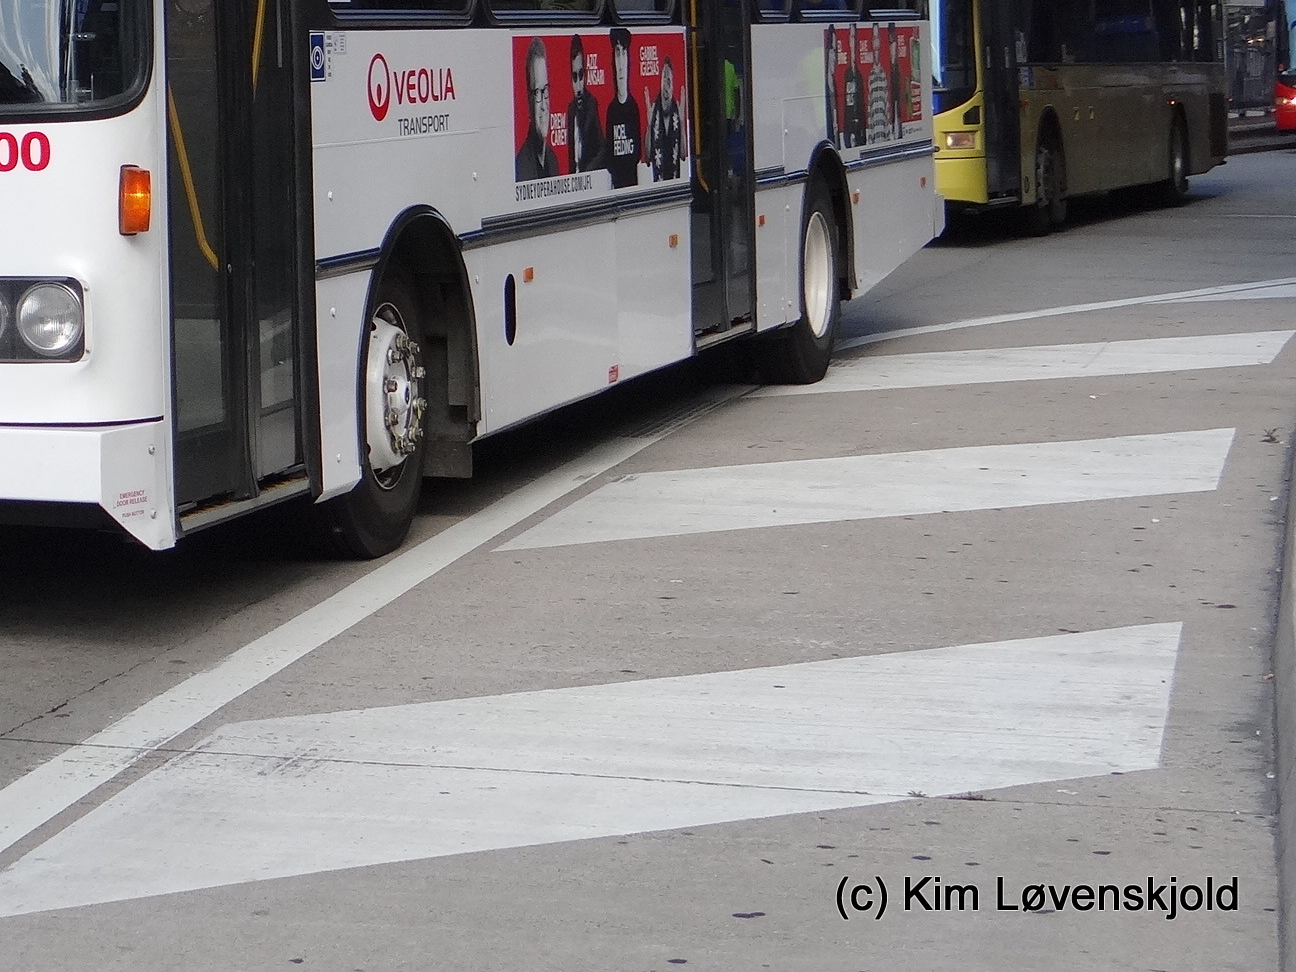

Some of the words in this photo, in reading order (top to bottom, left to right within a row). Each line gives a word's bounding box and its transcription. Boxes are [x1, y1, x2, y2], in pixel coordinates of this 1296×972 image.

[586, 54, 598, 70] AZIZ
[586, 70, 605, 85] ANSARI
[393, 68, 456, 105] VEOLIA
[398, 114, 450, 136] TRANSPORT
[550, 113, 566, 130] DREW
[551, 129, 567, 146] CAREY
[613, 124, 627, 140] NOEL
